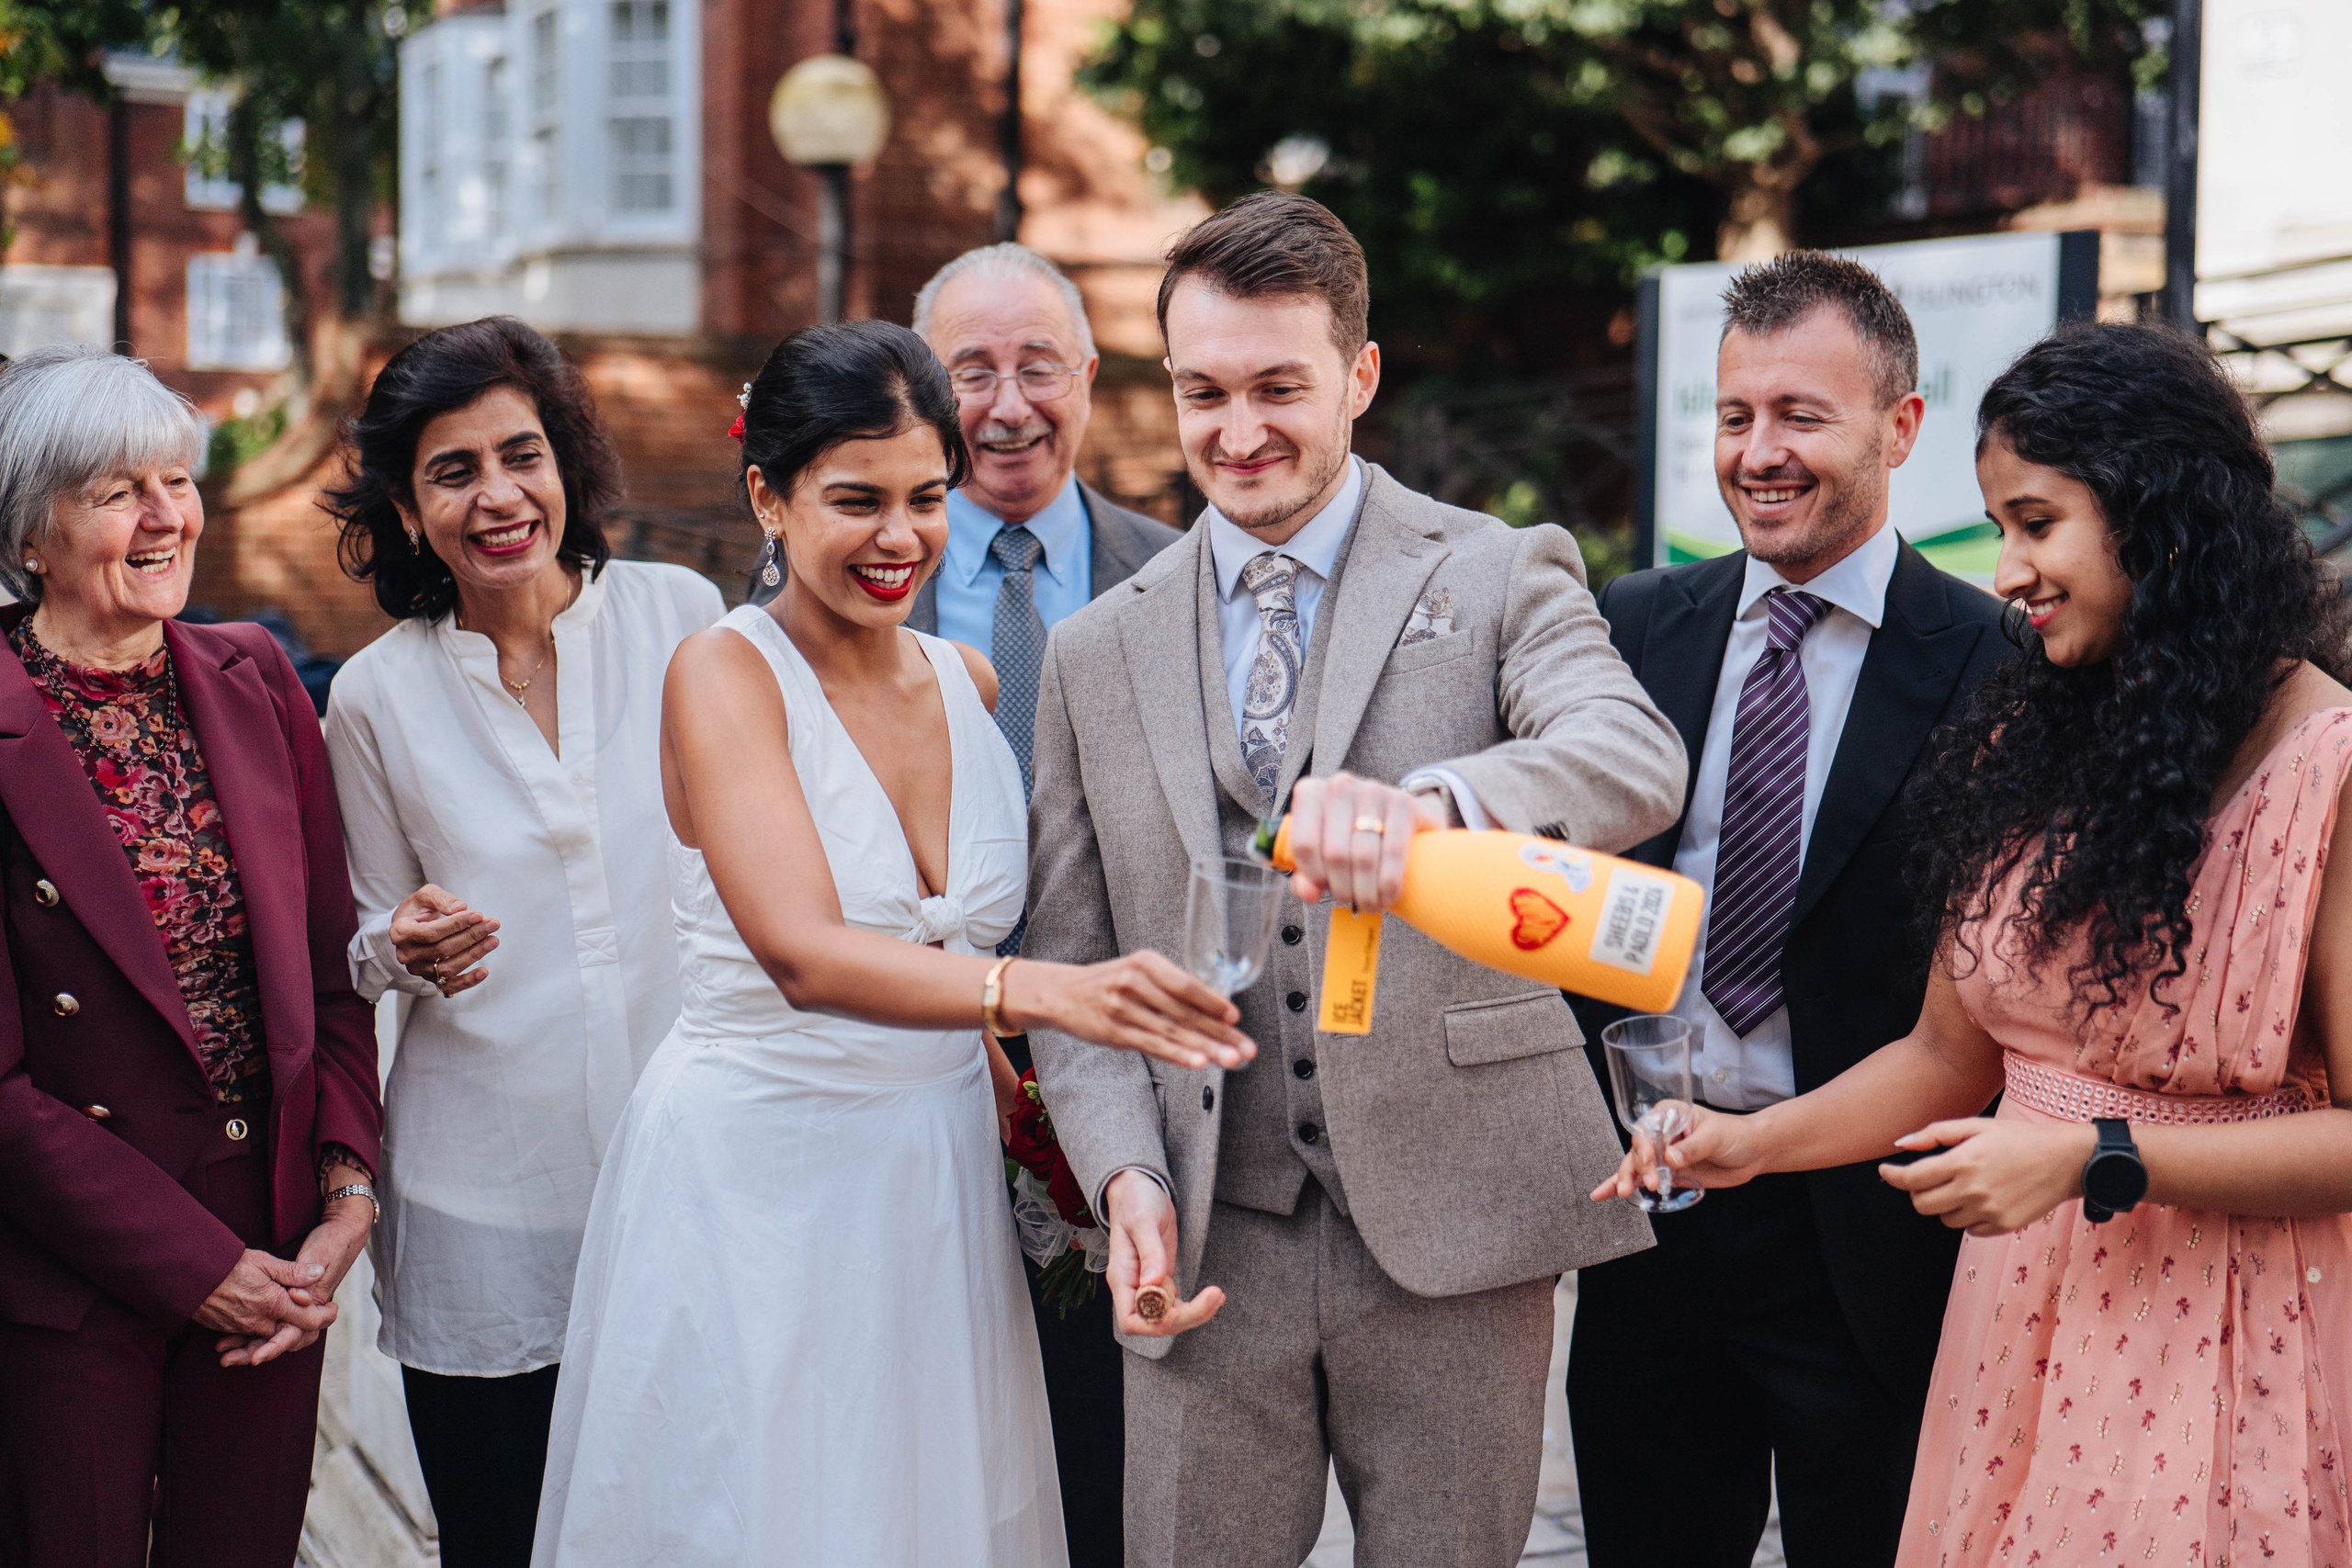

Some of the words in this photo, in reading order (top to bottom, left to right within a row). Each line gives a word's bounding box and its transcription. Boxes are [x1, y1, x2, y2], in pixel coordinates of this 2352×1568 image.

[1603, 895, 1637, 950] SHEEBS
[1623, 916, 1655, 964] PAOLO
[1332, 1002, 1348, 1024] ICE
[1346, 979, 1368, 1027] JACKET
